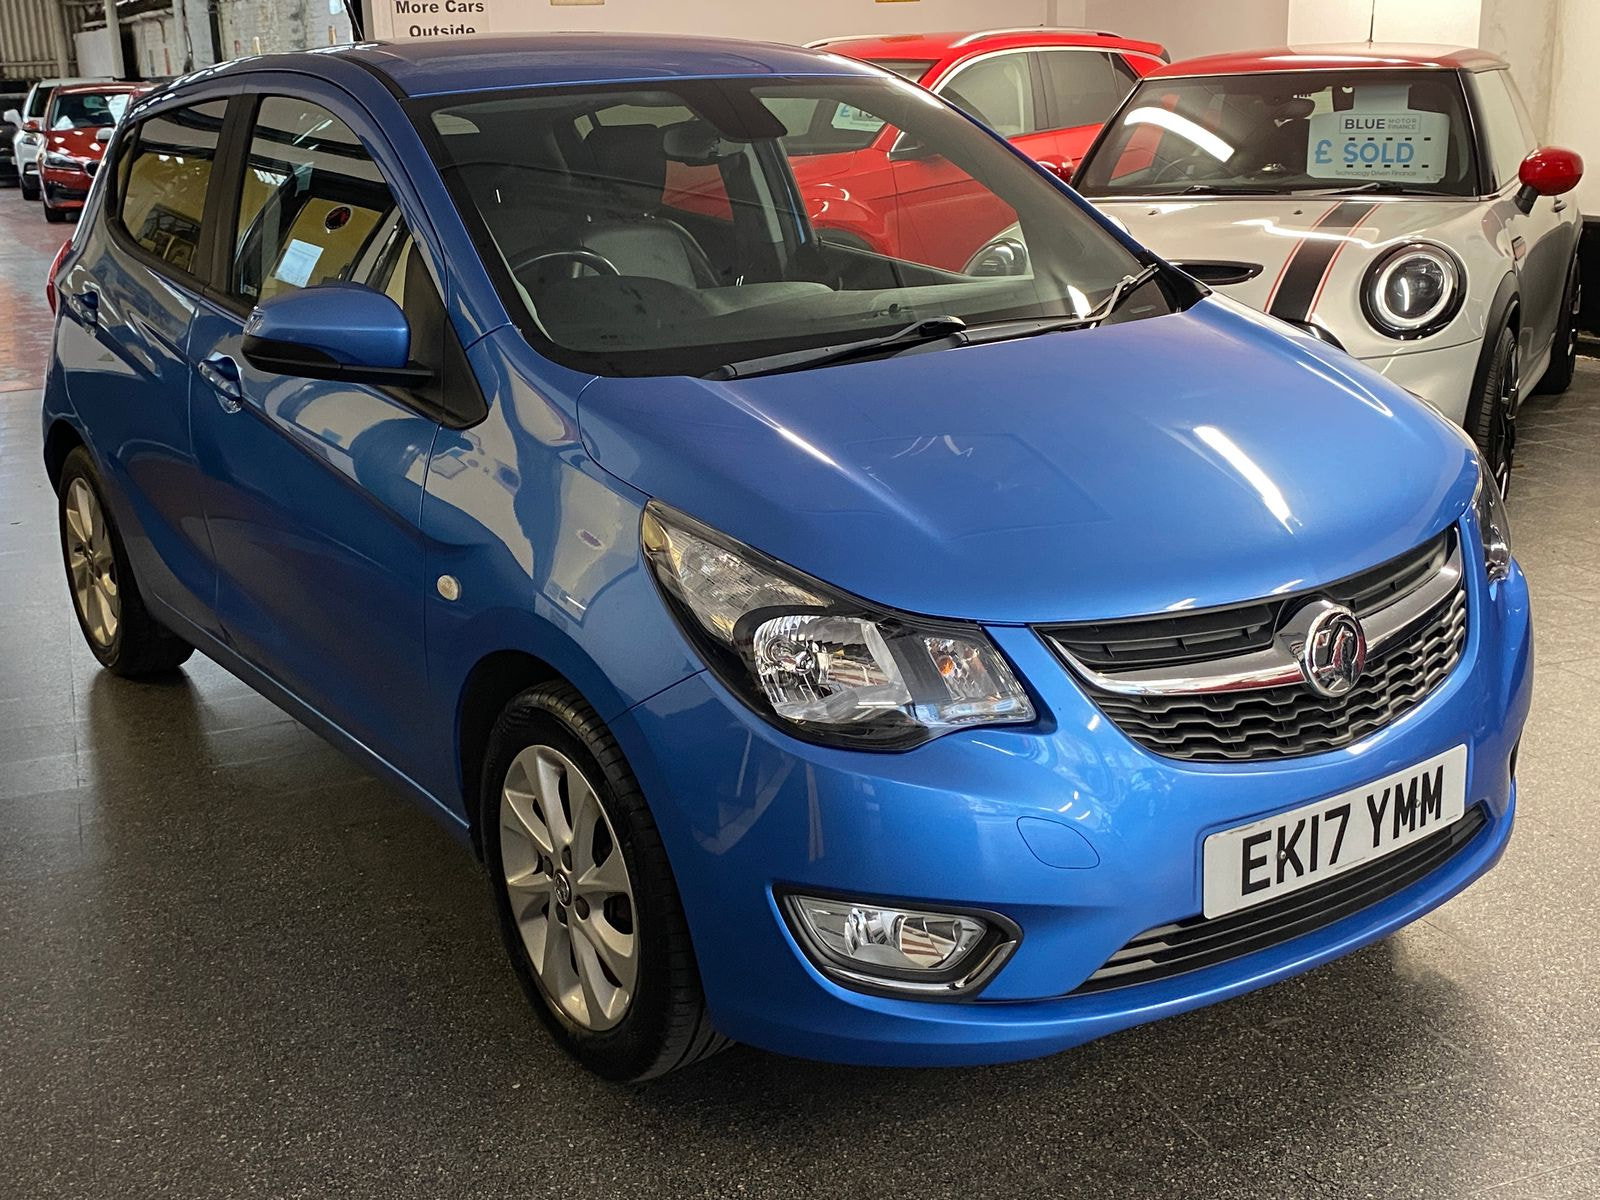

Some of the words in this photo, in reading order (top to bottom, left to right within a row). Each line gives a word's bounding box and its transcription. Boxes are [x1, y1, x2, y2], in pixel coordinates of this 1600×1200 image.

[396, 0, 439, 14] More
[445, 0, 485, 13] Cars
[409, 24, 476, 37] Outside
[1344, 118, 1386, 129] BLUE
[1314, 139, 1333, 164] £
[1343, 142, 1415, 163] SOLD
[1241, 803, 1351, 896] EK17
[1366, 765, 1444, 849] YMM
